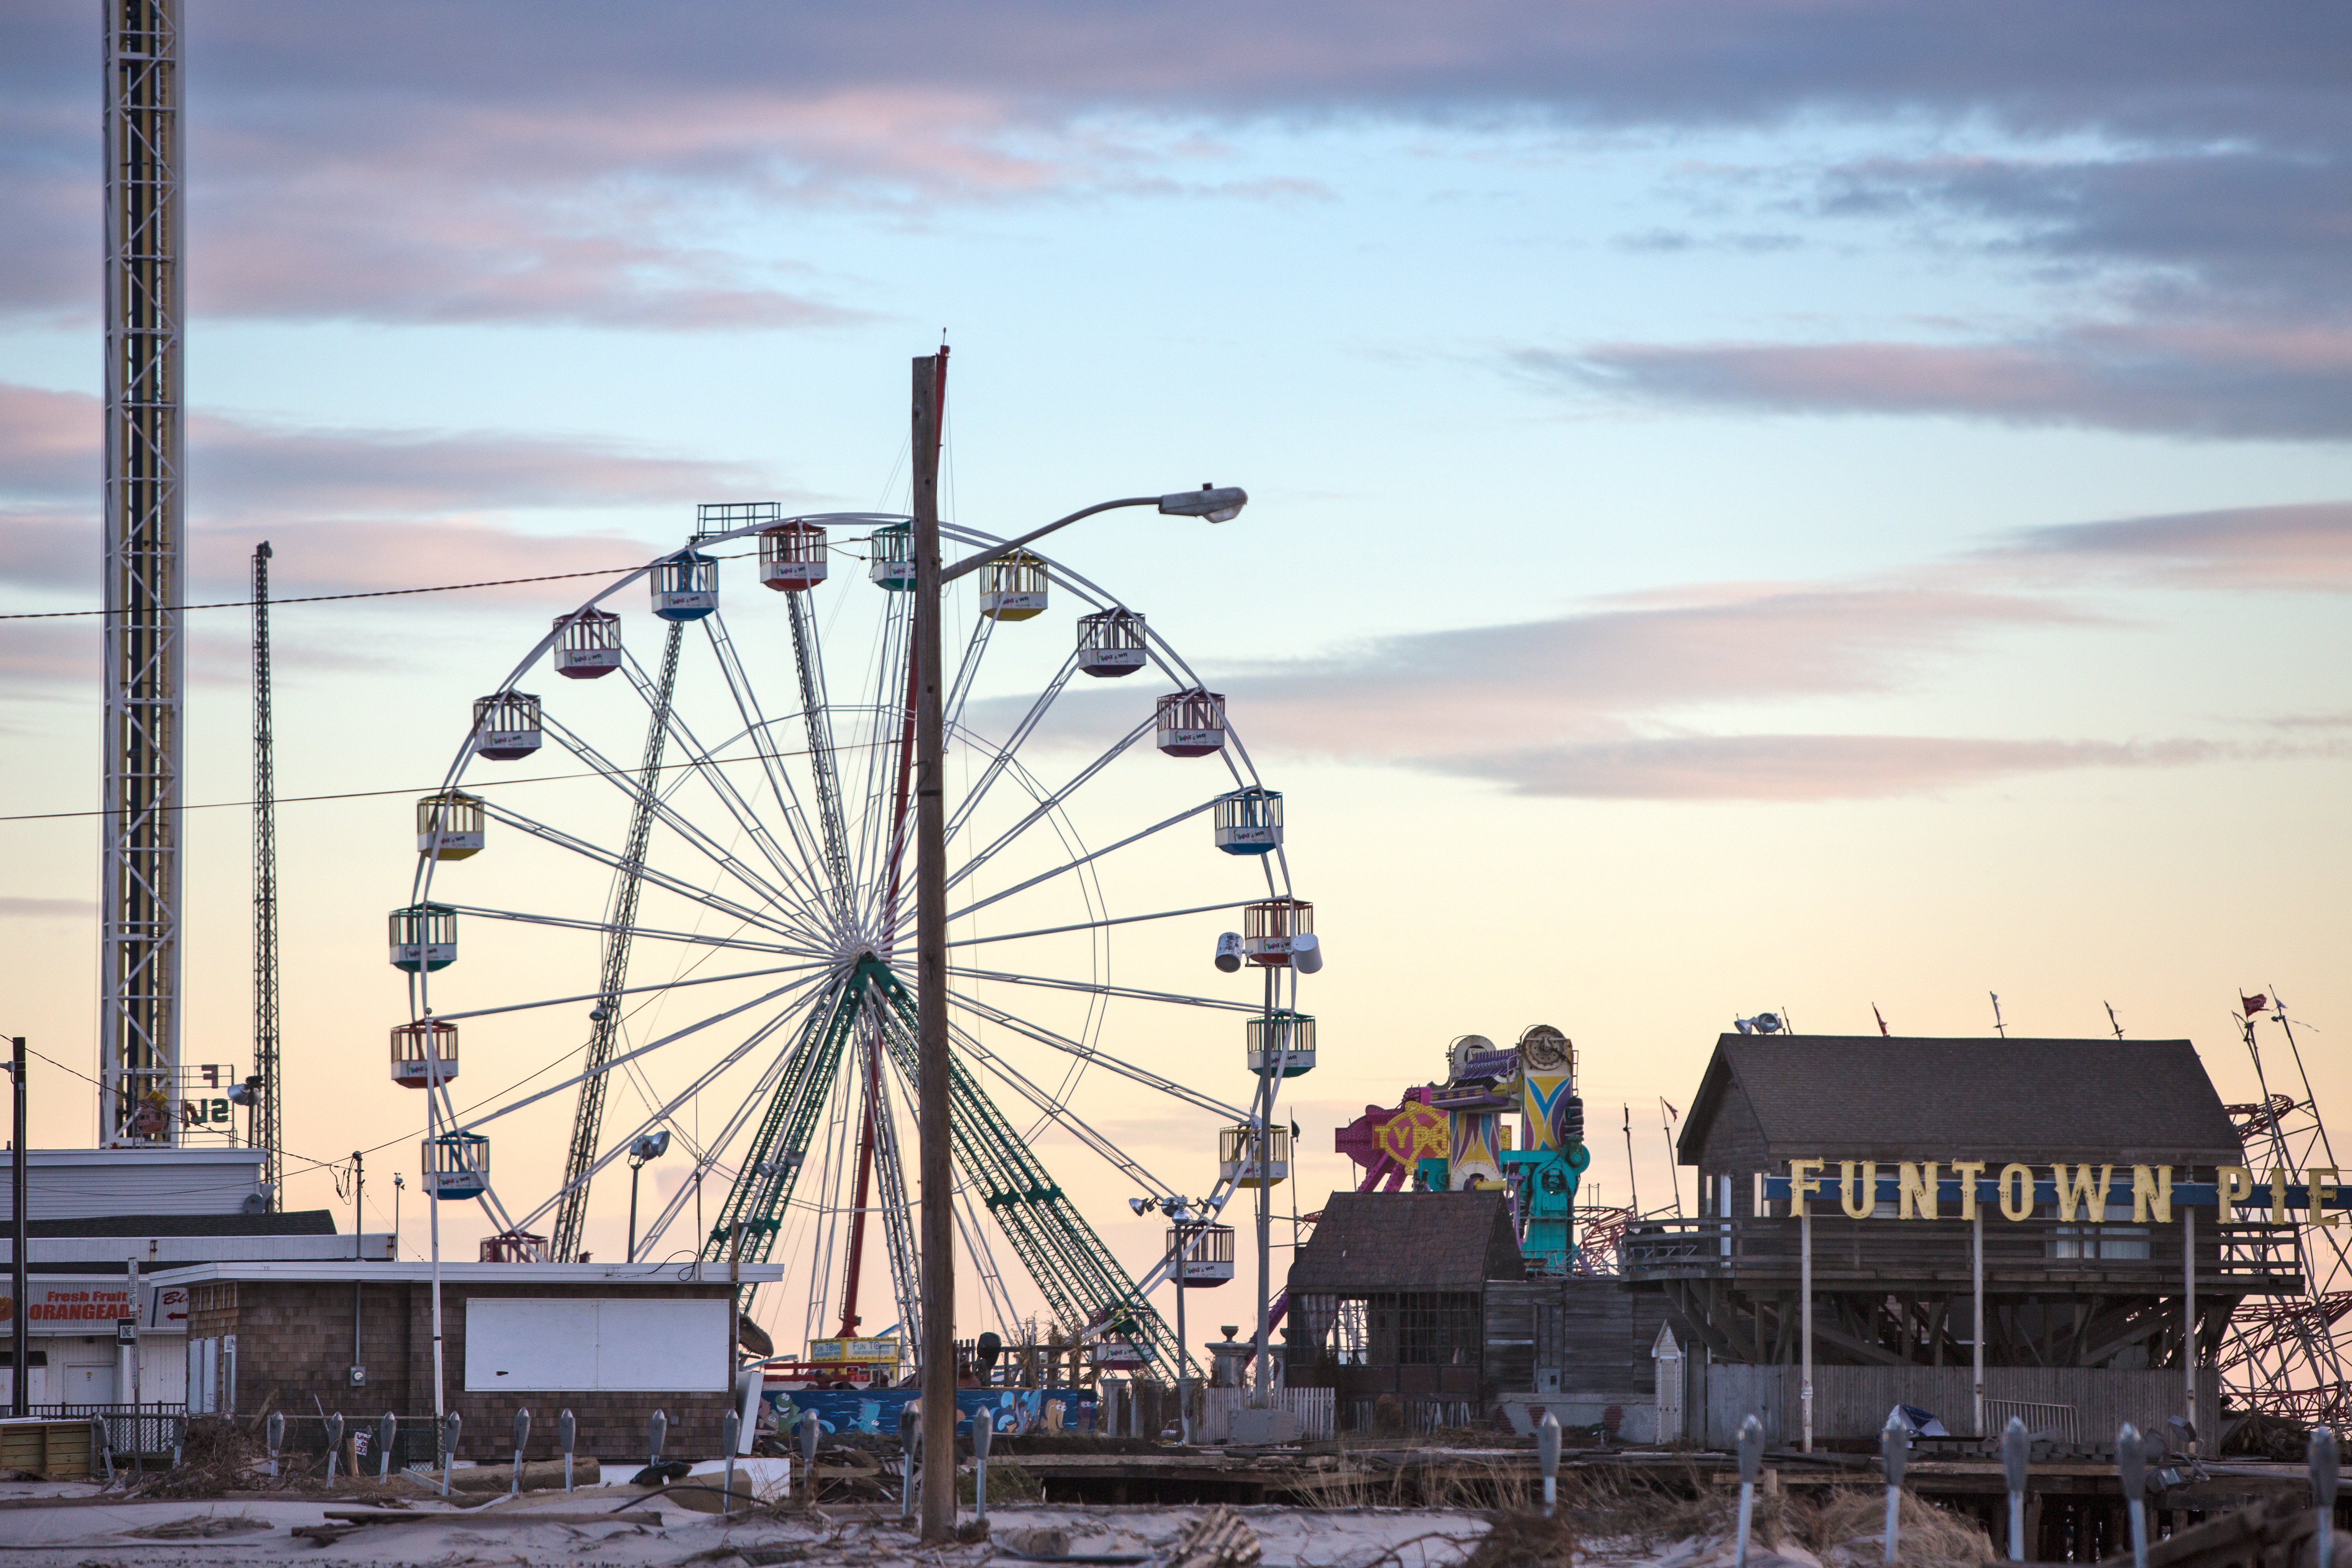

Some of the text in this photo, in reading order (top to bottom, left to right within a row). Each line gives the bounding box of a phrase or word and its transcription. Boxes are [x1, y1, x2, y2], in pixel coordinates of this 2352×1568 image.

[1789, 1157, 2174, 1223] FUNTOWN
[47, 1291, 127, 1302] Fresh Fruit
[122, 1326, 131, 1337] ONE
[853, 1341, 866, 1350] FUN
